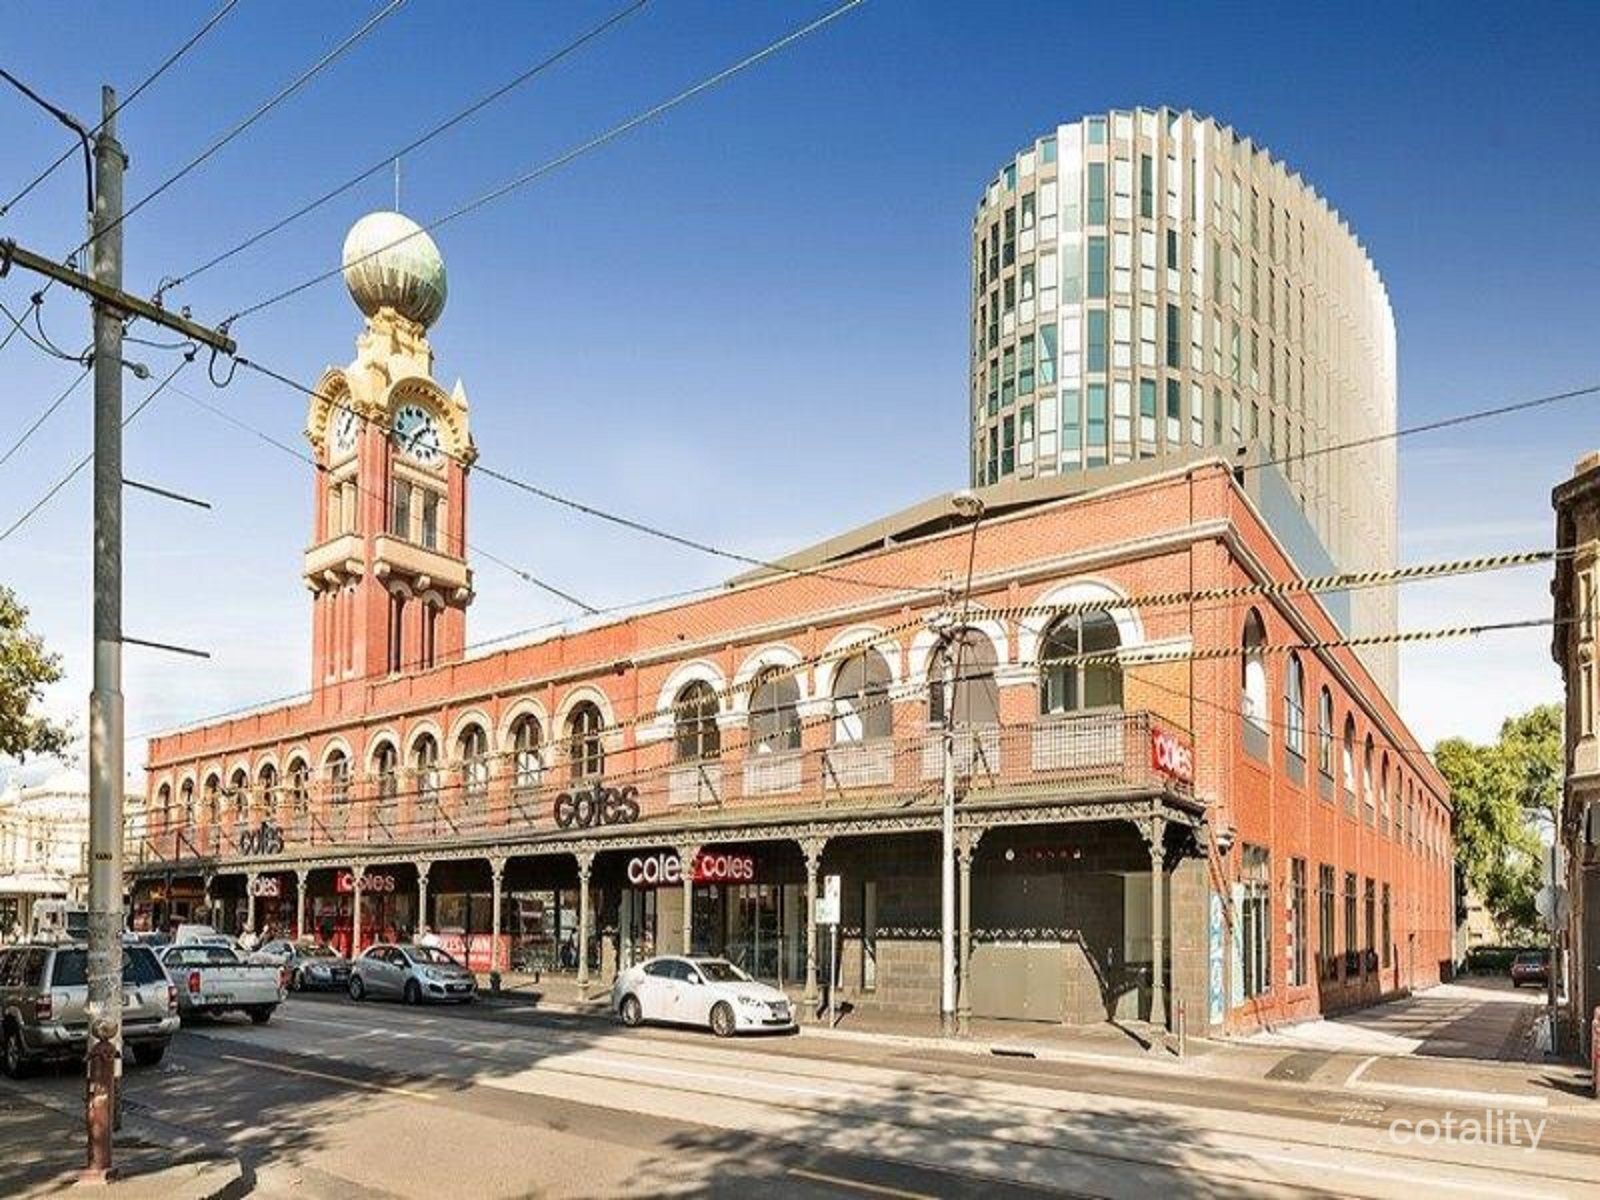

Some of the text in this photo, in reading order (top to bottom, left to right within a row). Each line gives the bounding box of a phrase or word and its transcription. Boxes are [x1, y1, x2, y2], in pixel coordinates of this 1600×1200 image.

[554, 786, 640, 829] coles
[240, 822, 284, 856] coles
[628, 853, 684, 884] cole
[702, 855, 754, 879] coles
[253, 876, 279, 897] oles
